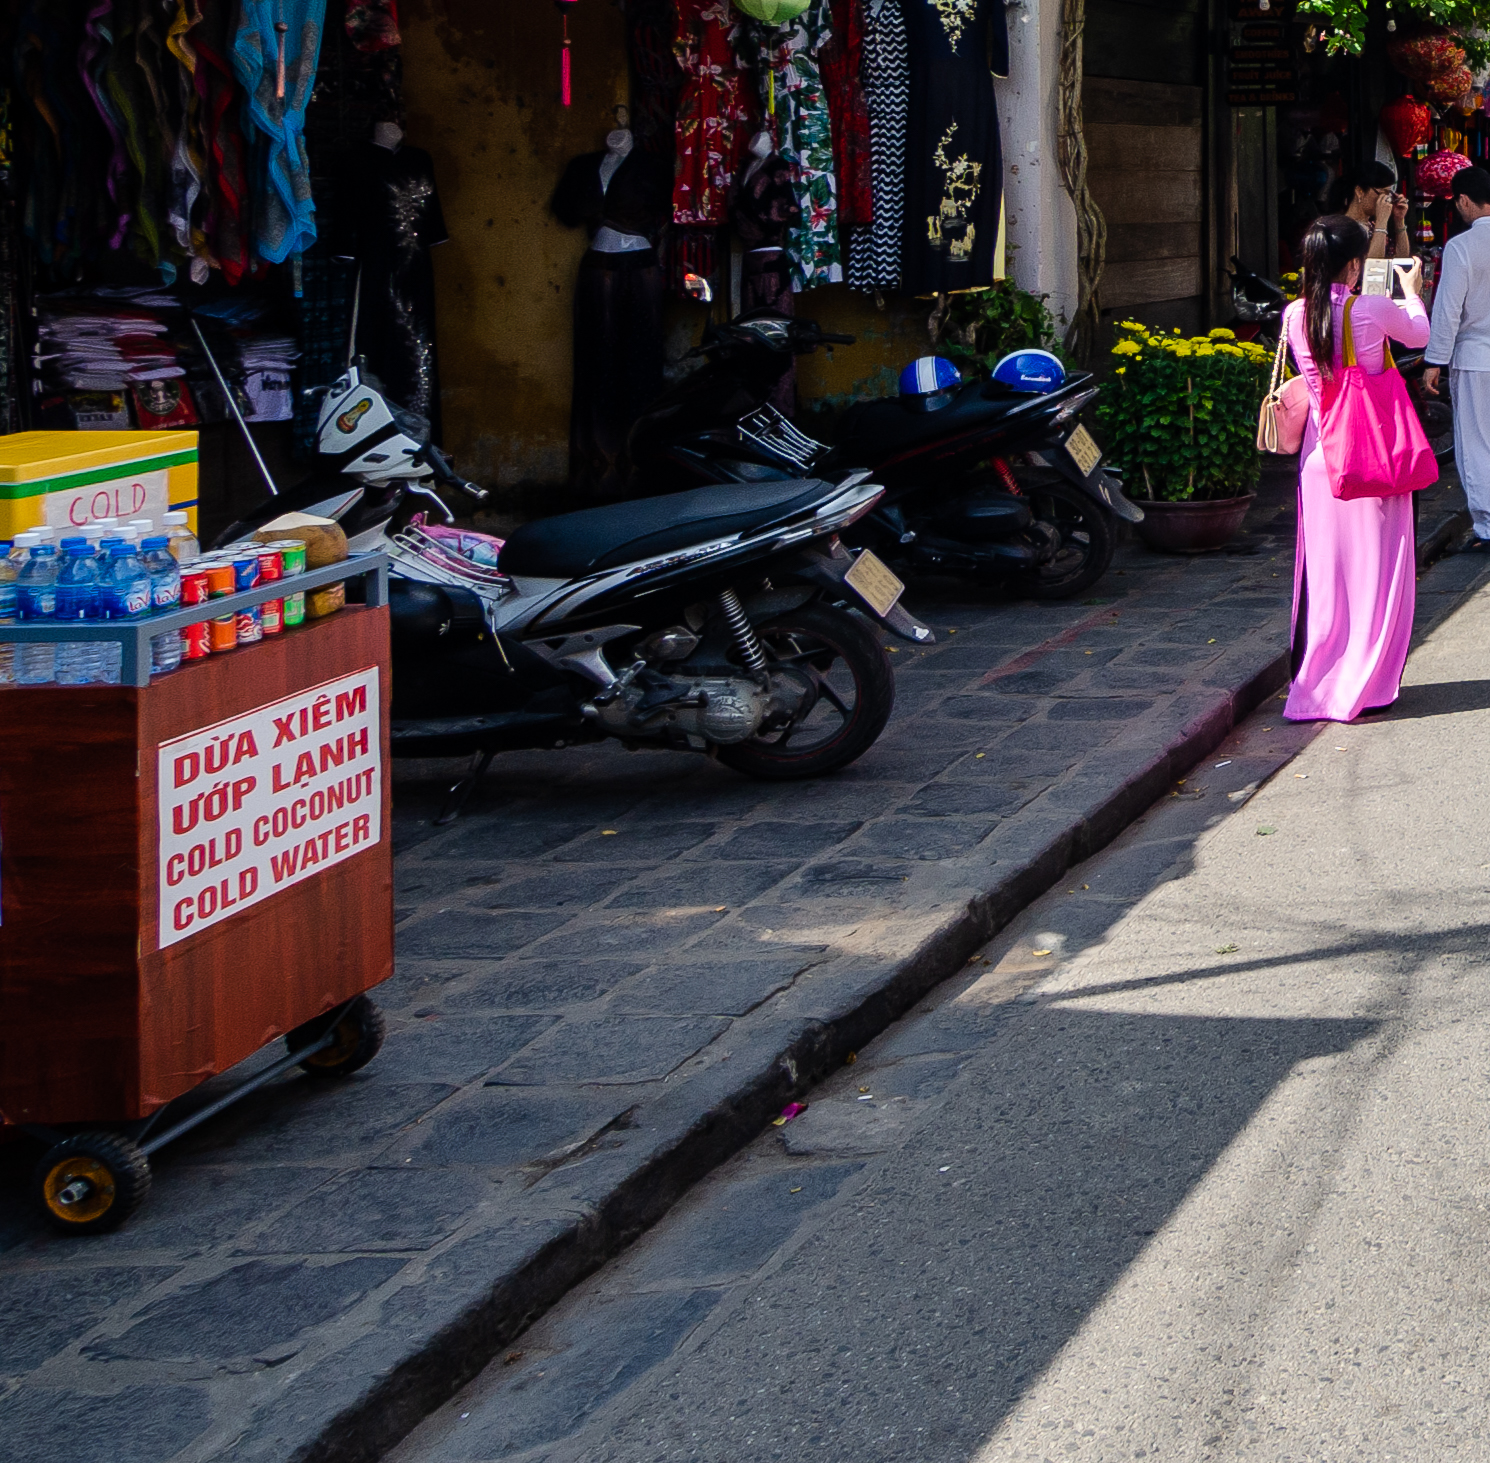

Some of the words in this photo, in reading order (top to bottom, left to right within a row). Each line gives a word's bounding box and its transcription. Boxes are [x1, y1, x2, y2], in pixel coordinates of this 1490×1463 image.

[69, 482, 147, 526] COLD
[172, 779, 257, 836] ƯỚP
[272, 727, 369, 790] LẠNH
[173, 735, 259, 789] DỪA
[272, 684, 367, 749] XIÊM
[166, 829, 243, 888] COLD
[253, 766, 376, 848] COCONUT
[173, 865, 259, 932] COLD
[270, 813, 371, 884] WATER
